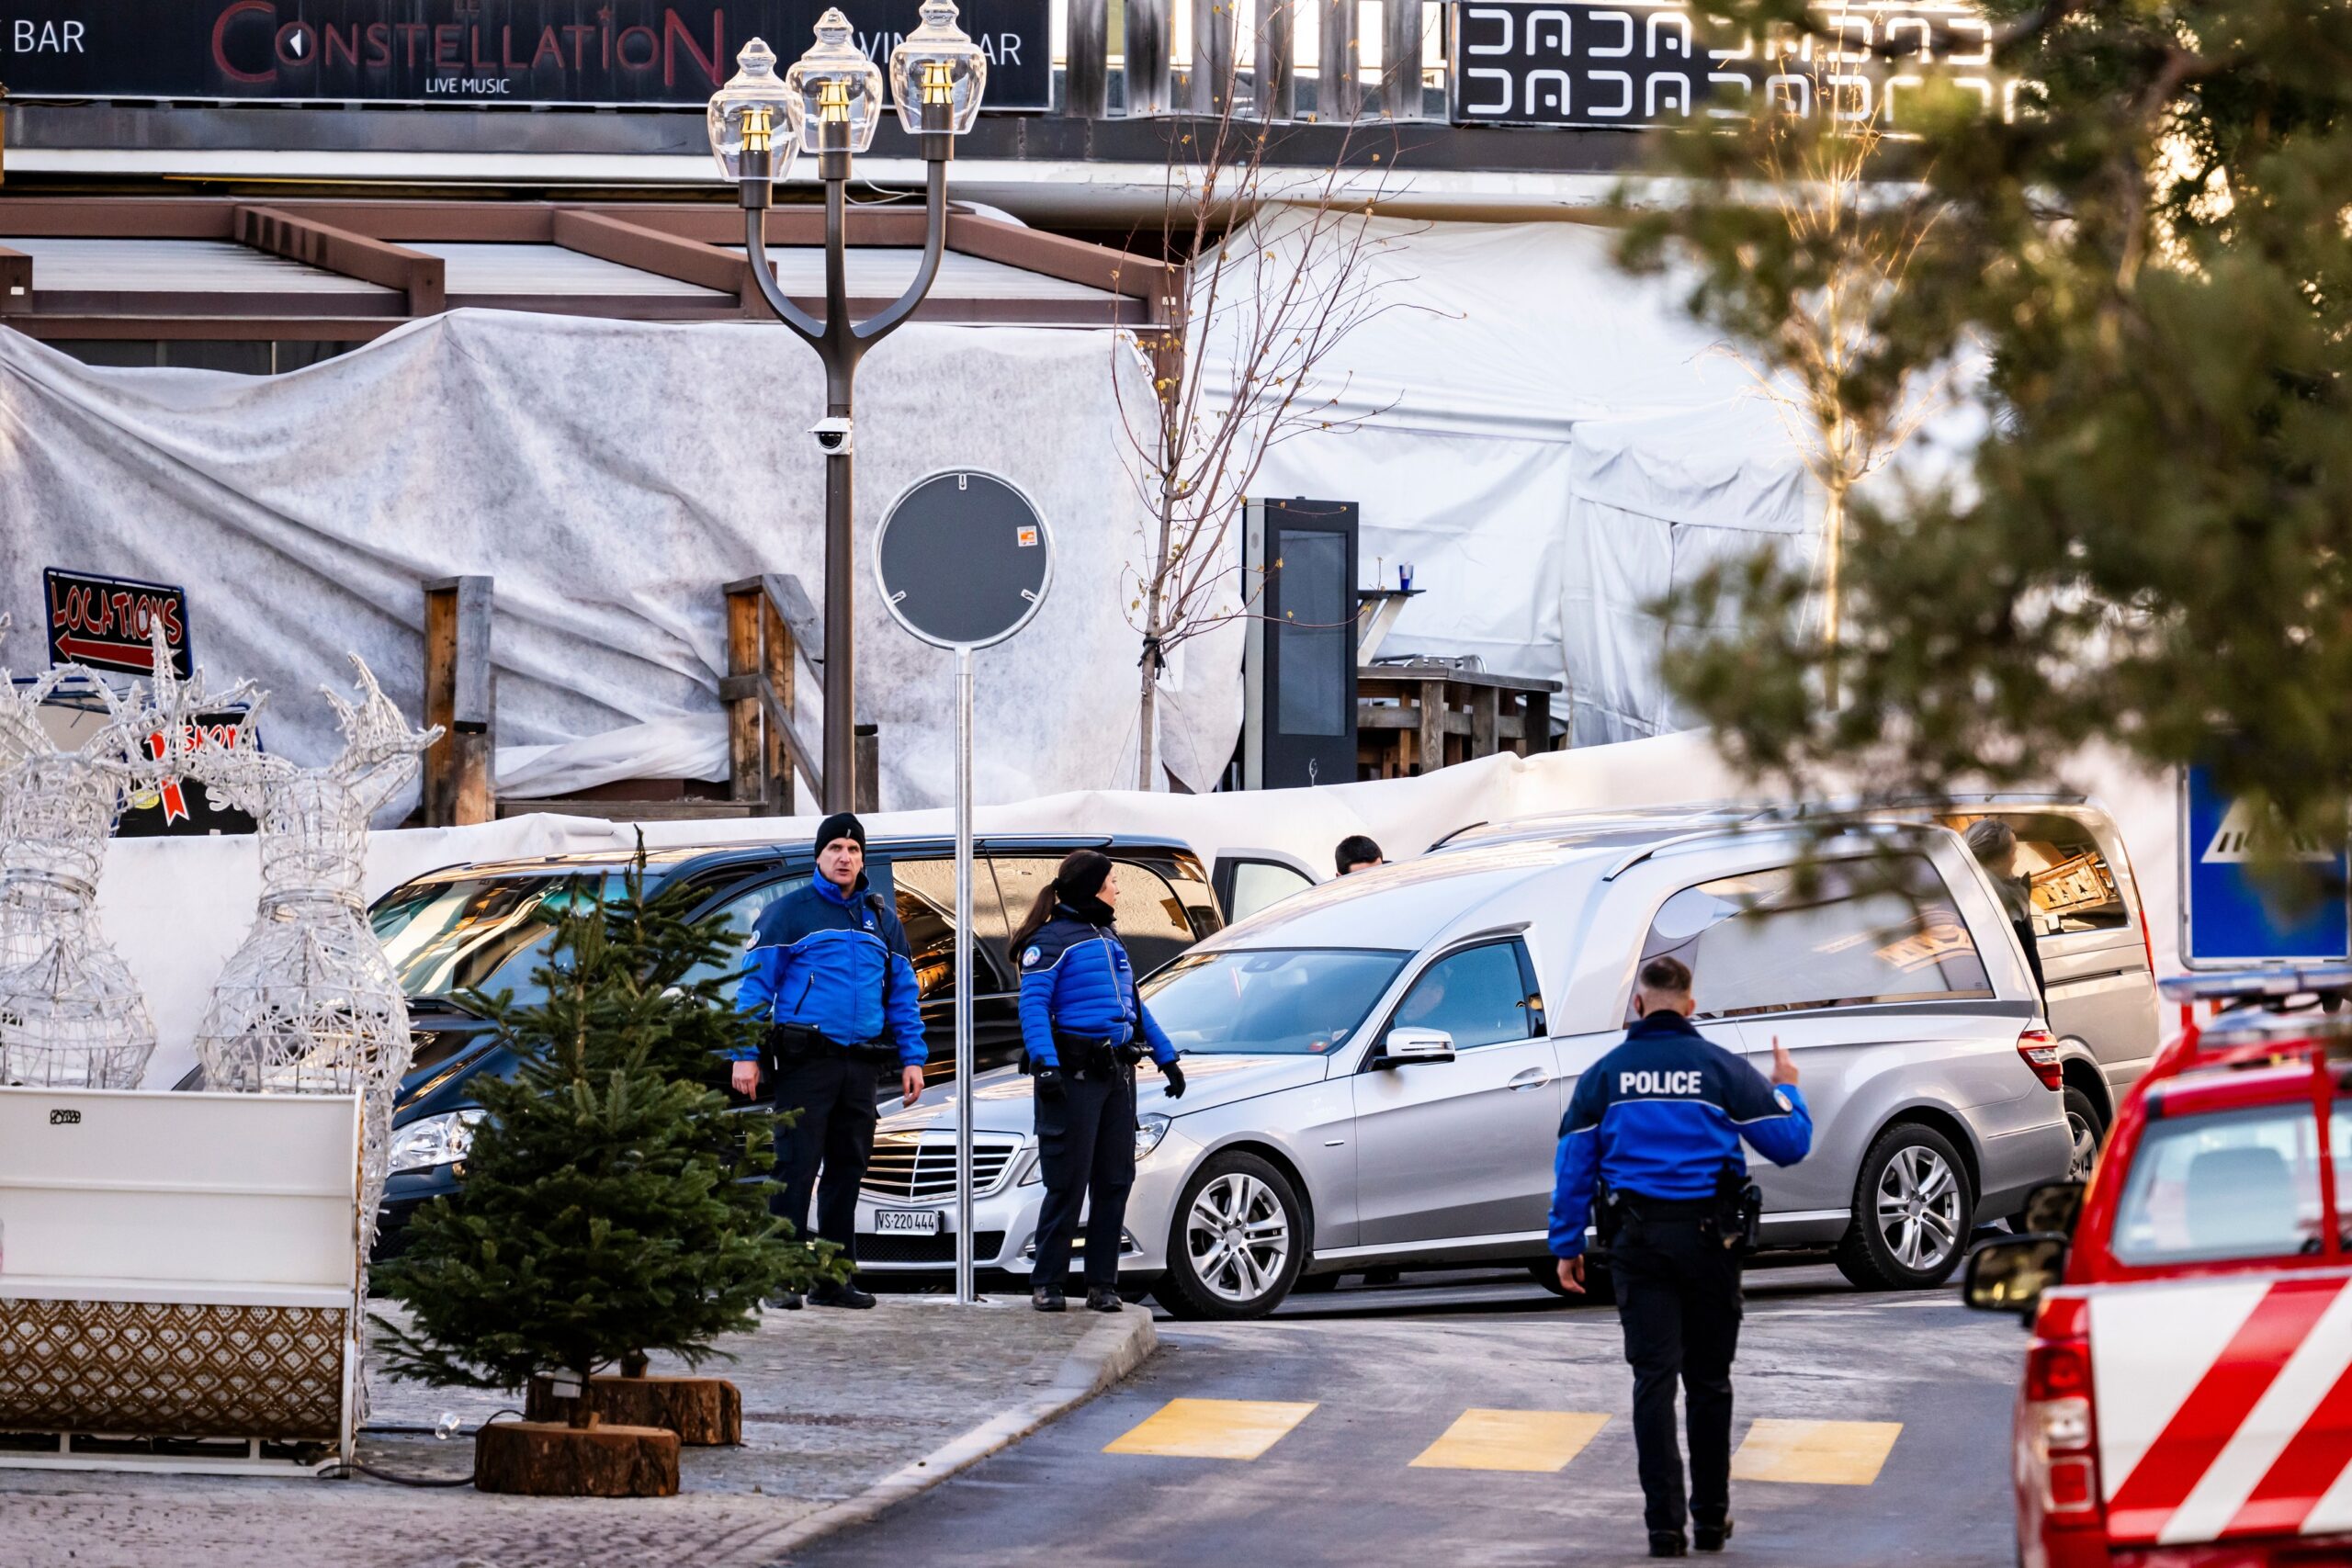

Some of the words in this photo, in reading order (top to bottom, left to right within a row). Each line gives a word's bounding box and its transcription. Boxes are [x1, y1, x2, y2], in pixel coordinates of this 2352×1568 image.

[14, 19, 85, 53] BAR
[211, 0, 725, 87] CONSTELLATION
[978, 33, 1021, 66] AR
[425, 77, 458, 94] LIVE
[461, 78, 511, 94] MUSIC
[51, 581, 183, 645] LOCATIONS
[1619, 1070, 1703, 1095] POLICE
